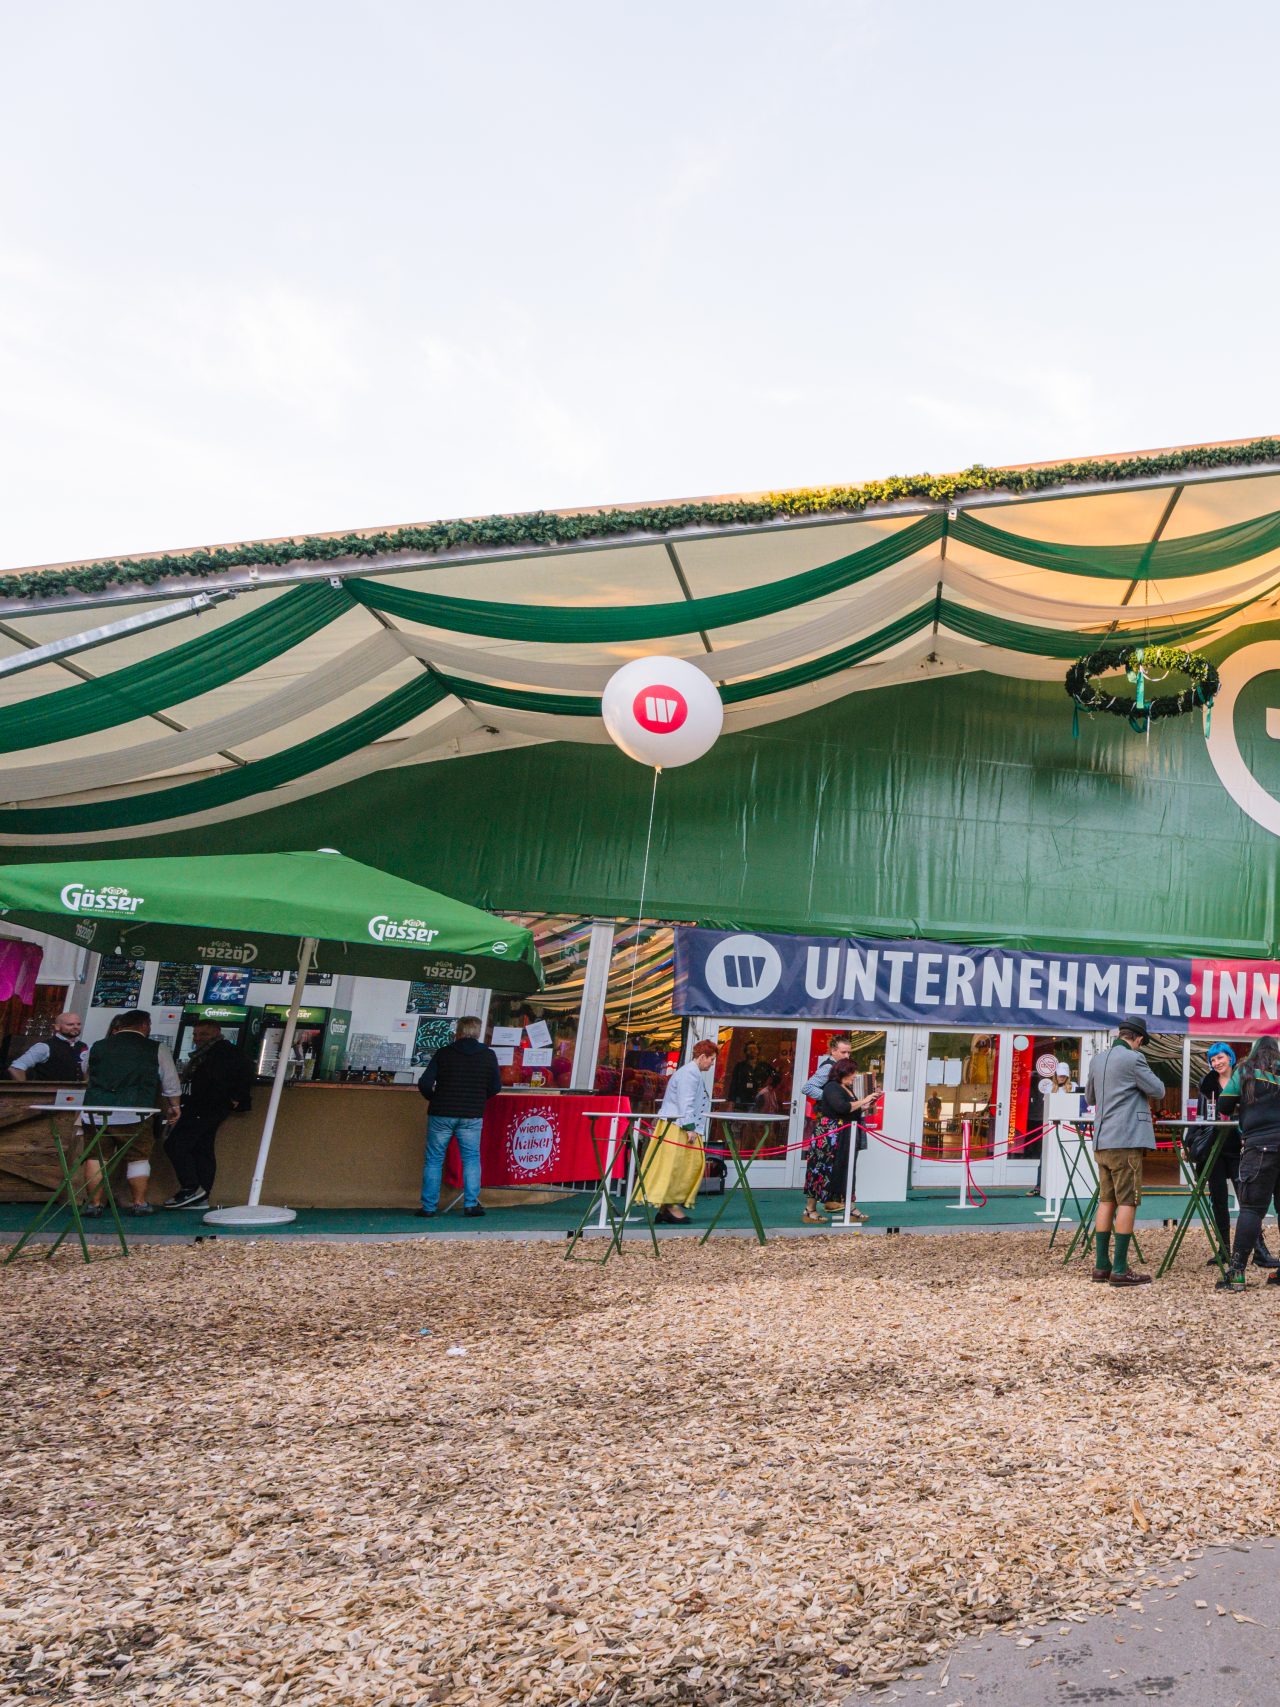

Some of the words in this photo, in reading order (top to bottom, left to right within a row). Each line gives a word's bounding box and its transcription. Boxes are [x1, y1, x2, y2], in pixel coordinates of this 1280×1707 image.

[60, 883, 144, 911] Gösser
[368, 915, 439, 941] Gösser
[519, 1123, 550, 1134] wiener
[514, 1136, 552, 1150] Kaiser
[518, 1152, 545, 1163] wiesn
